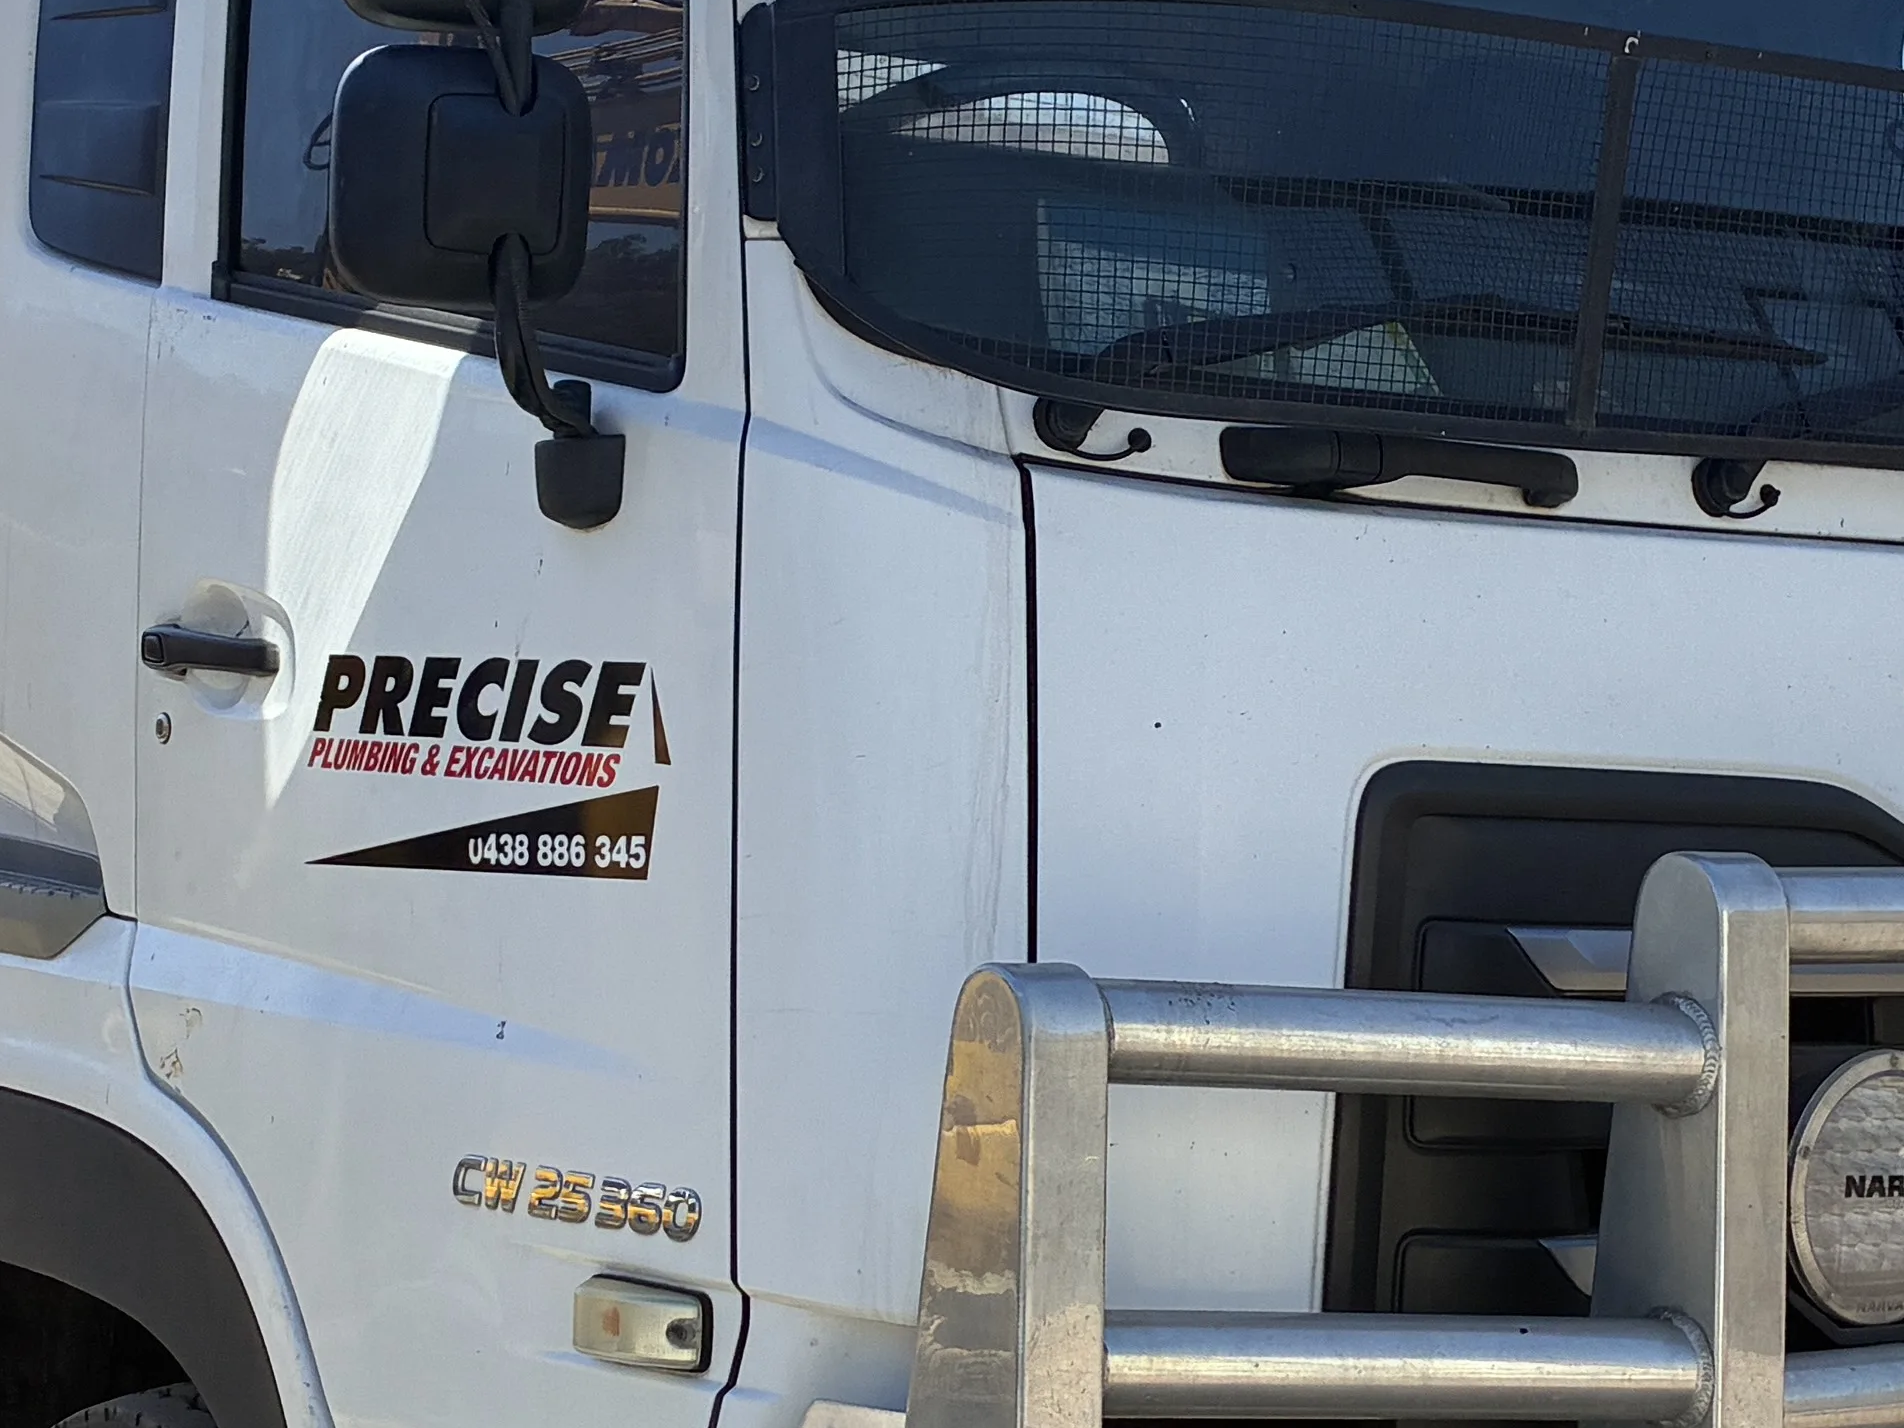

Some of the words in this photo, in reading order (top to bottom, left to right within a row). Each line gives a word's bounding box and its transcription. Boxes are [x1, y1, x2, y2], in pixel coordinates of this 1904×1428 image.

[312, 654, 647, 750] PRECISE
[307, 738, 421, 775] PLUMBING
[421, 748, 441, 776] &
[443, 745, 621, 789] EXCAVATIONS
[468, 834, 529, 867] 0438
[537, 834, 586, 868] 886
[594, 835, 647, 871] 345
[452, 1153, 527, 1214] CW
